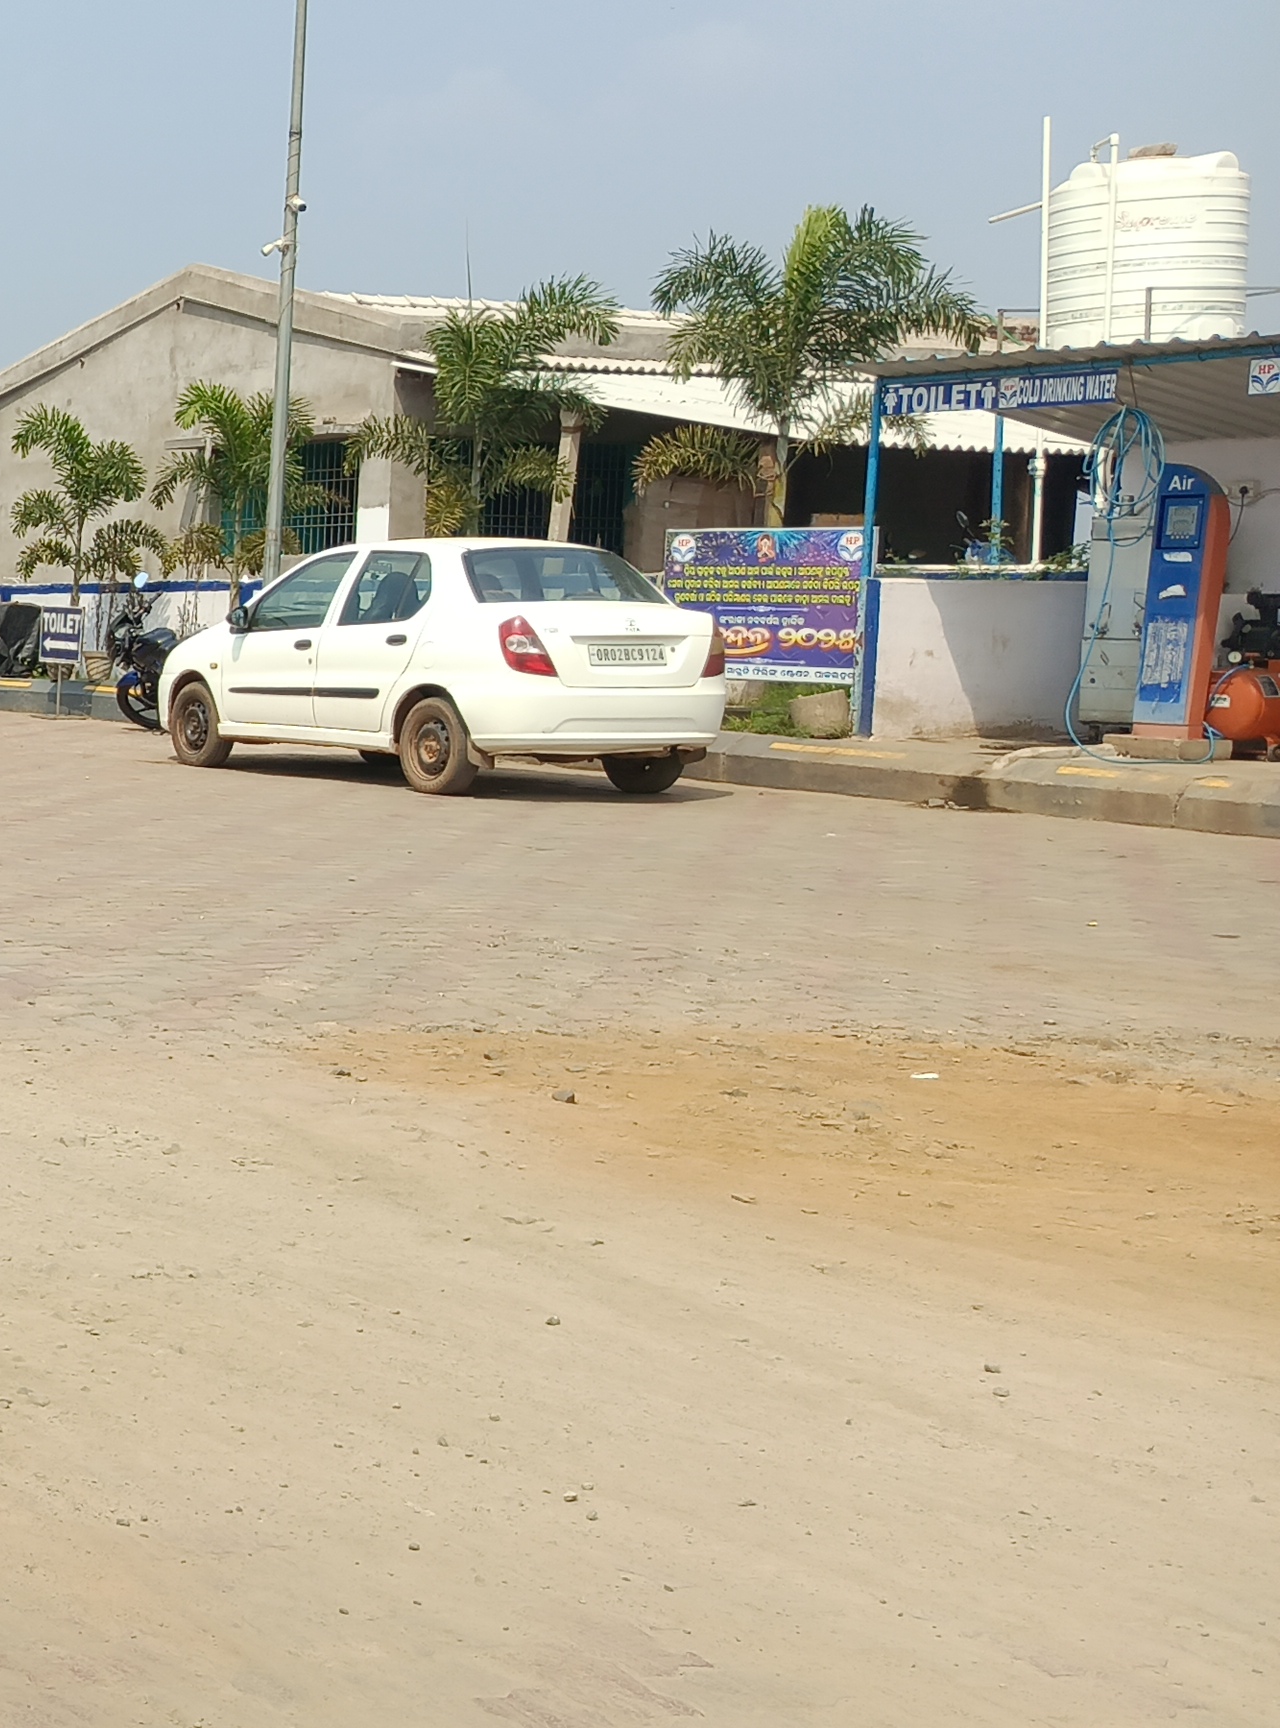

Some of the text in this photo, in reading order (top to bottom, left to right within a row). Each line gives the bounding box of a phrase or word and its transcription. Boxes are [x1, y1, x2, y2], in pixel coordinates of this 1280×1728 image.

[1257, 363, 1275, 375] HP
[898, 383, 983, 413] TOILET
[1017, 379, 1040, 404] COLD
[1041, 376, 1084, 403] DRINKING
[1085, 373, 1117, 400] WATER
[1168, 475, 1196, 492] Air
[43, 610, 80, 634] TOILET
